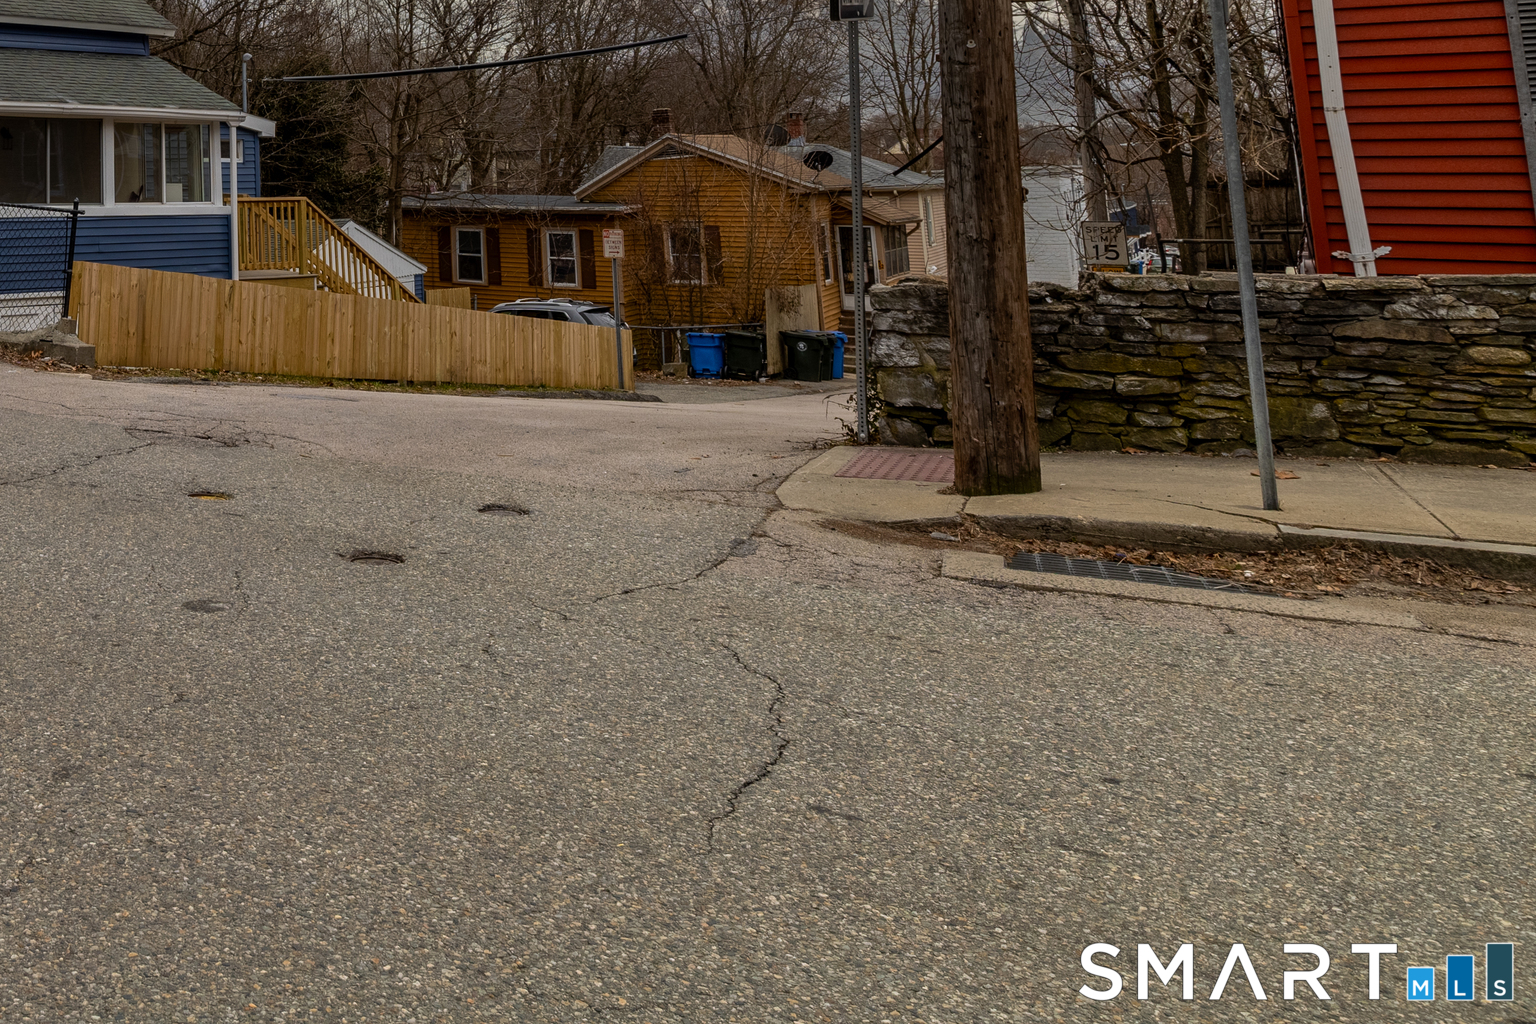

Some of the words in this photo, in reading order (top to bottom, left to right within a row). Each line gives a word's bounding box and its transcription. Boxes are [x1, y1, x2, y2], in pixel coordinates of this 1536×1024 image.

[1085, 226, 1122, 234] SPEED
[1090, 235, 1118, 243] LIMT
[1092, 244, 1120, 261] 15
